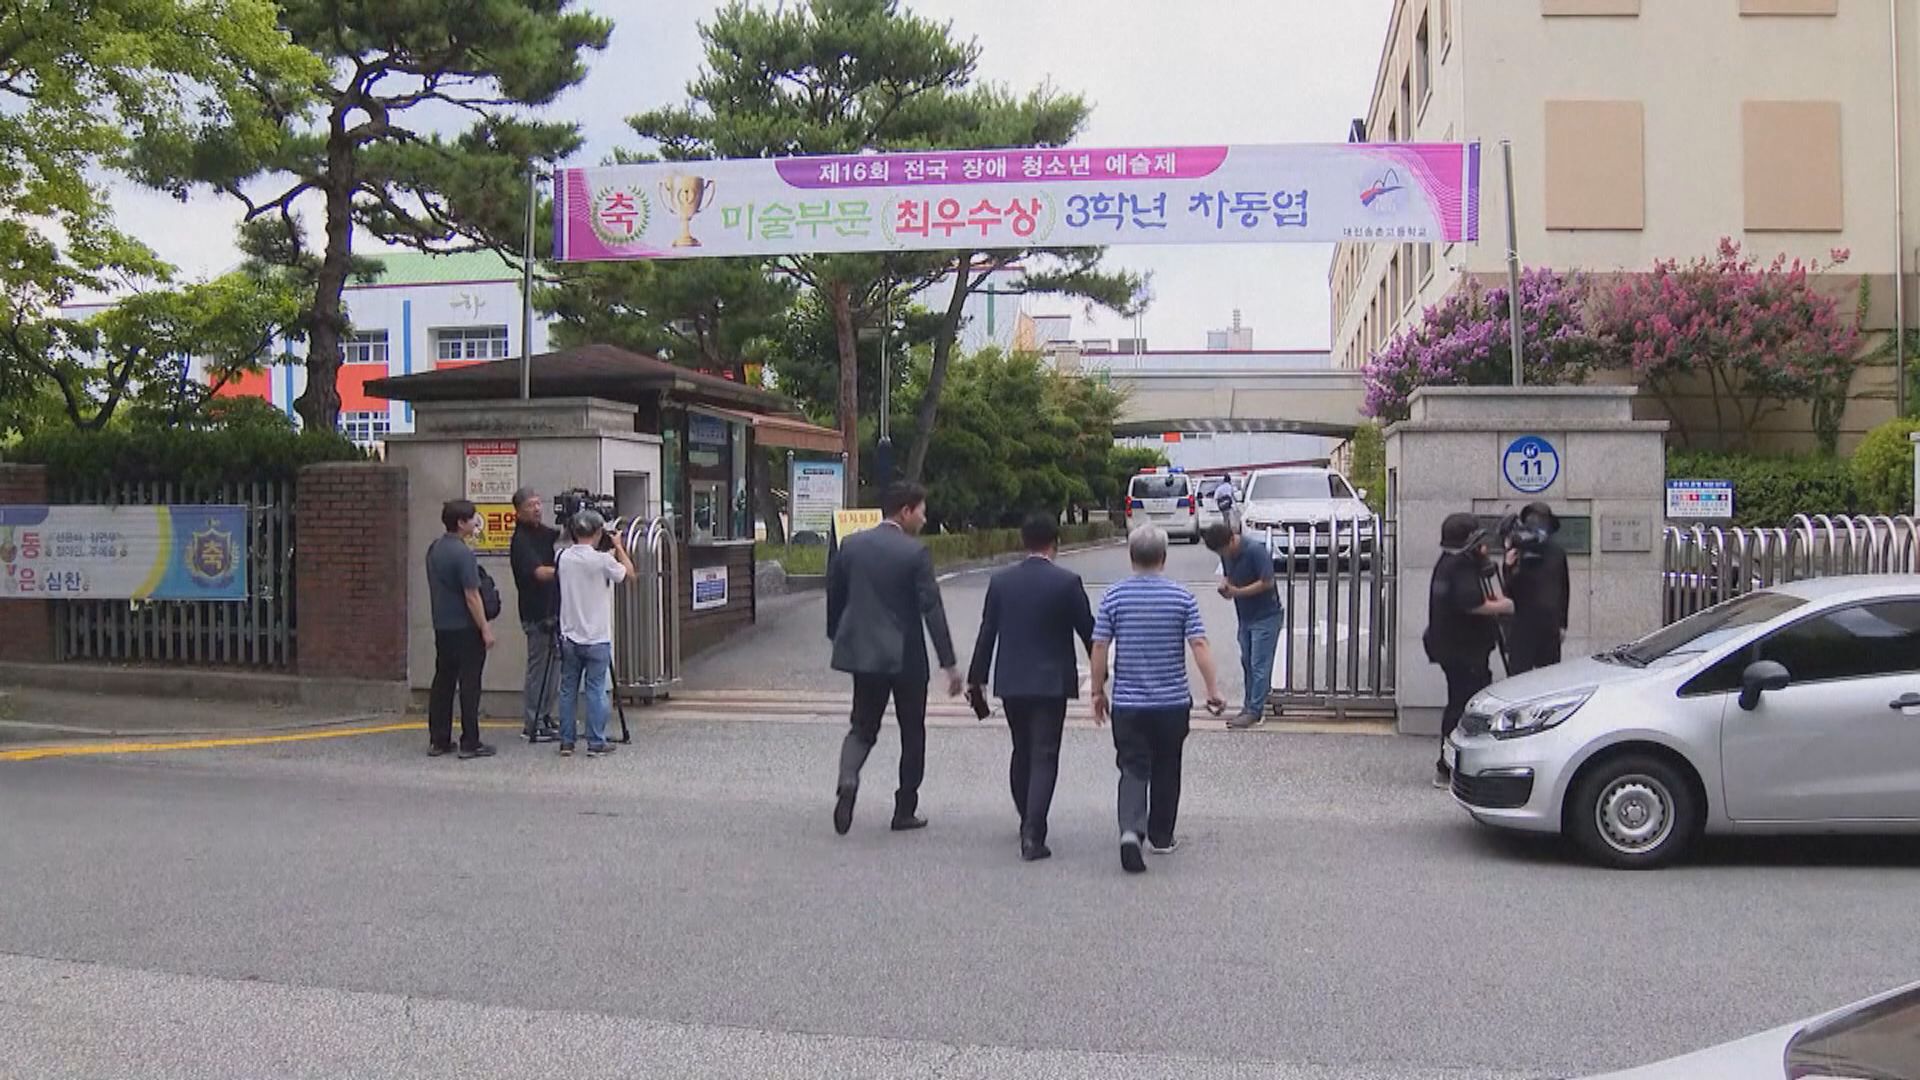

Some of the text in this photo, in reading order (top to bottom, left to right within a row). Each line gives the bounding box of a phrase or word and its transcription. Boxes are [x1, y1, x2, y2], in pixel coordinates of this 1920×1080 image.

[819, 152, 1176, 183] 제16회 전국 장애 청소년 예술제
[600, 192, 639, 234] 축
[721, 189, 1309, 240] 미술부문 최우수상 3학년 차동엽
[1520, 460, 1542, 476] 11
[488, 512, 518, 531] 금연
[202, 540, 225, 570] 축
[19, 567, 36, 592] 은
